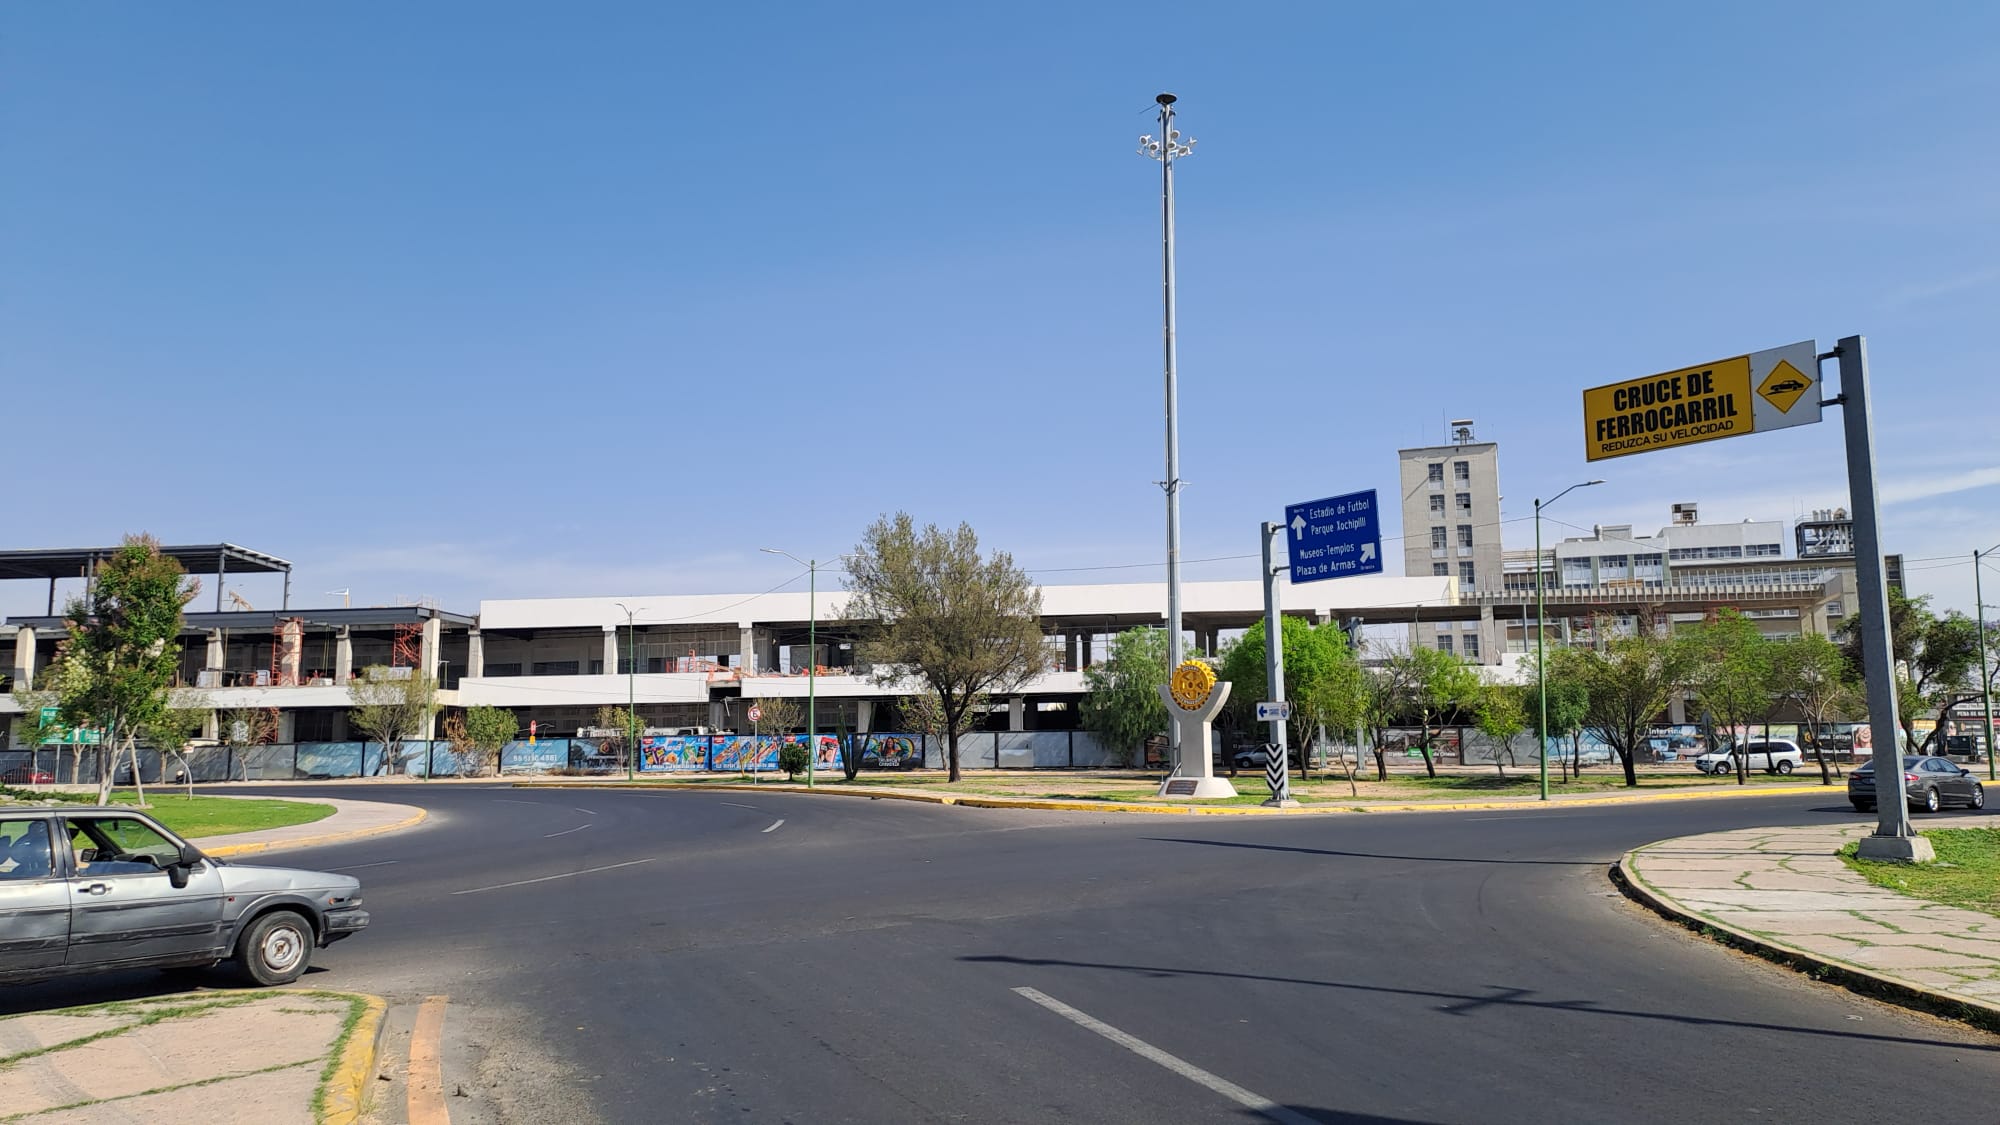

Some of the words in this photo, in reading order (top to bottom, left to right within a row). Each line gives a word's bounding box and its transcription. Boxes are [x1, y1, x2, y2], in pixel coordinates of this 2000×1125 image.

[1614, 377, 1682, 411] CRUCE
[1687, 370, 1714, 397] DE
[1596, 394, 1737, 441] FERROCARRIL
[1602, 436, 1651, 453] REDUZCA
[1653, 433, 1667, 444] SU
[1670, 420, 1733, 440] VELOCIDAD
[1309, 506, 1334, 519] Estadio
[1337, 504, 1345, 515] de
[1347, 499, 1370, 512] Futbol
[1311, 524, 1334, 536] Parque
[1336, 517, 1366, 531] Xochipilli
[1300, 542, 1355, 560] Museos-Templos
[1296, 566, 1317, 577] Plaza
[1319, 563, 1327, 573] de
[1331, 560, 1356, 572] Armas
